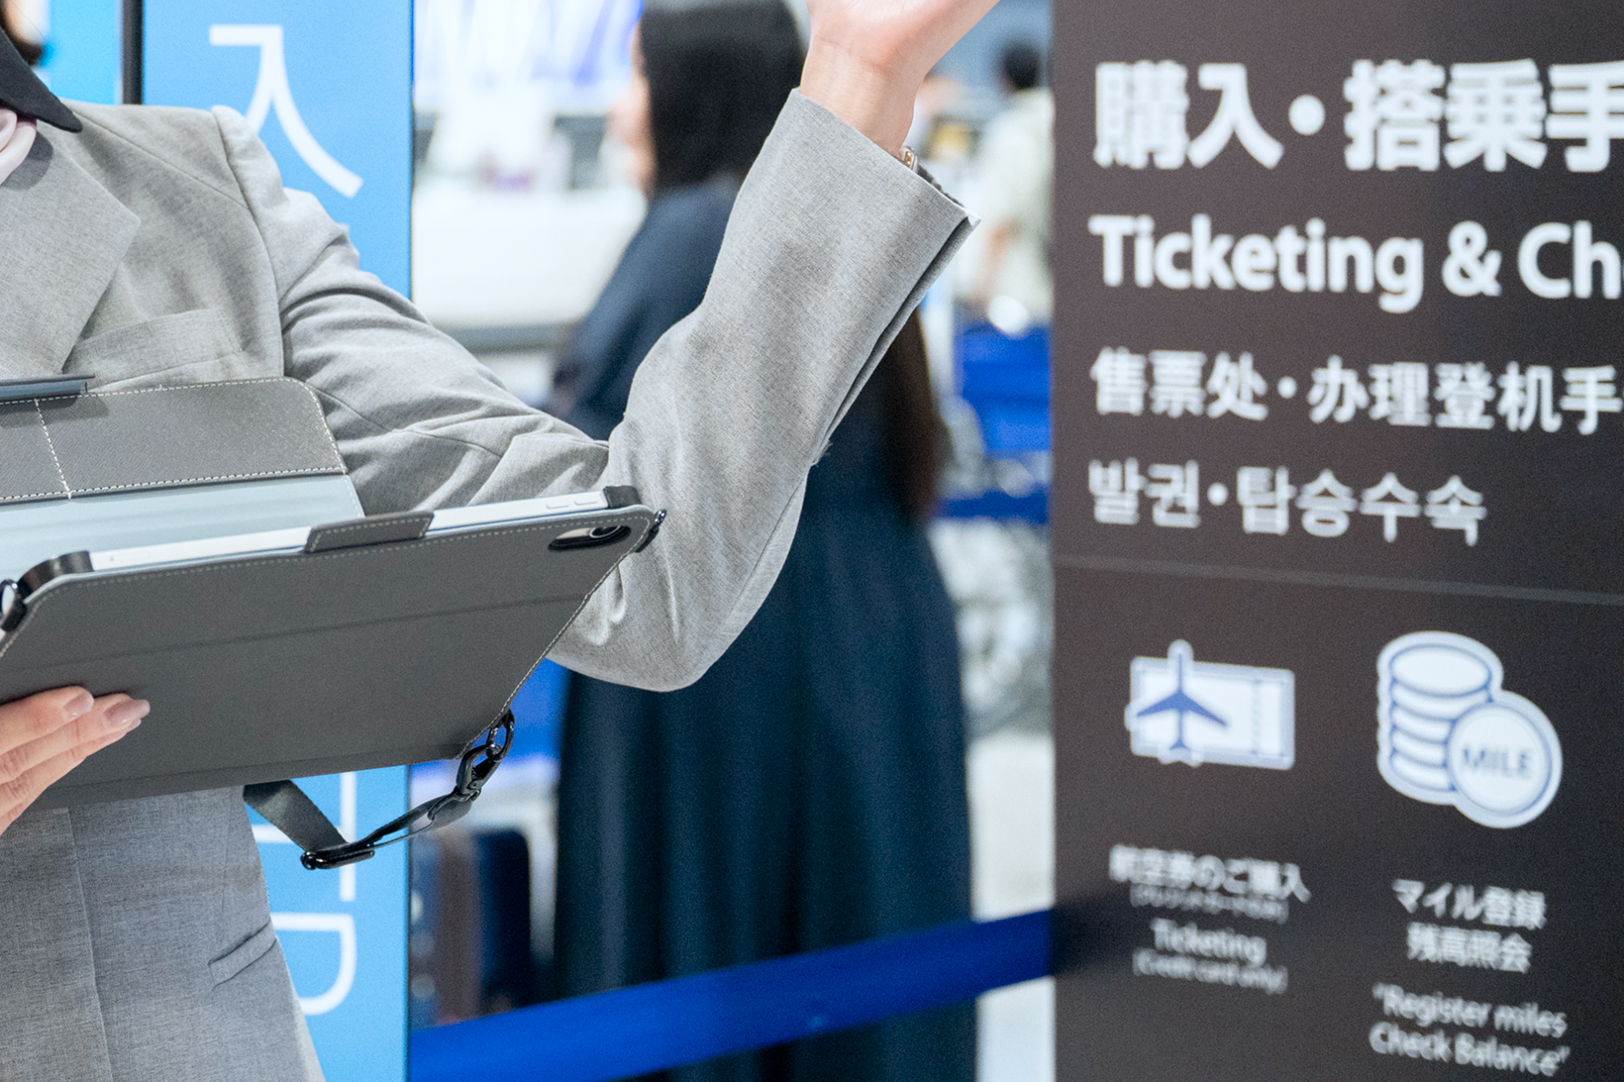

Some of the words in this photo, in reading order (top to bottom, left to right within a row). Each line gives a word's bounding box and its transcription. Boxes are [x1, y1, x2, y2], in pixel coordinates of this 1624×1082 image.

[1088, 214, 1425, 314] Ticketing
[1442, 221, 1502, 296] &
[1517, 220, 1624, 299] Ch
[1461, 744, 1535, 780] MILE
[1151, 918, 1266, 968] Ticketing
[1494, 1002, 1567, 1038] miles
[1369, 1021, 1453, 1062] Check
